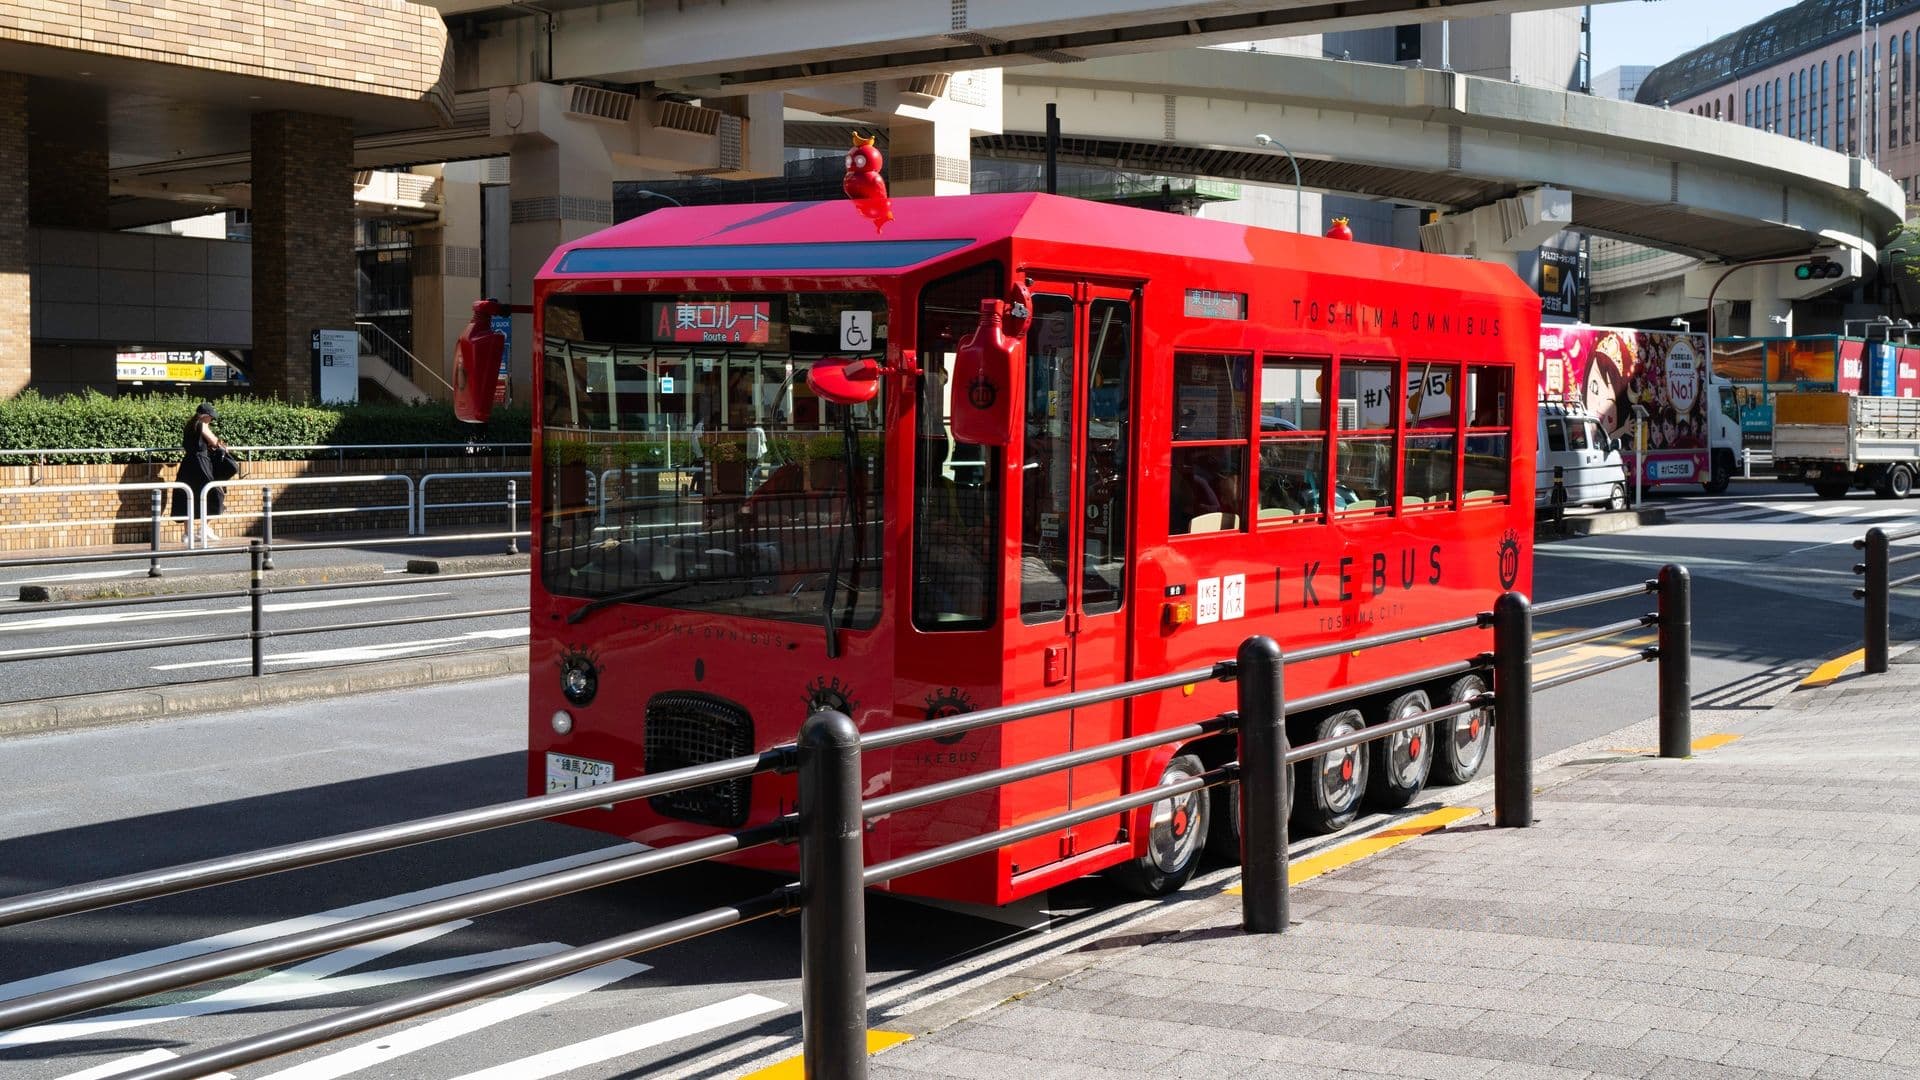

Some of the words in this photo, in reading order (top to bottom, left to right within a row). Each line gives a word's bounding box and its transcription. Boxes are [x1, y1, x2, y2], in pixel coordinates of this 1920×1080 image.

[676, 304, 769, 330] 東口ルート
[1293, 300, 1399, 328] TOSHIMA
[1412, 311, 1500, 337] OMNIBUS
[703, 331, 727, 342] Route
[734, 331, 740, 342] A
[1201, 584, 1217, 600] IKE
[1274, 544, 1441, 614] IKEBUS
[1200, 602, 1217, 617] BUS
[1320, 611, 1374, 632] TOSHIMA
[1380, 604, 1405, 620] CITY
[622, 616, 695, 635] TOSHIMA
[703, 624, 783, 648] OMNIBUS
[916, 752, 977, 764] IKEBUS
